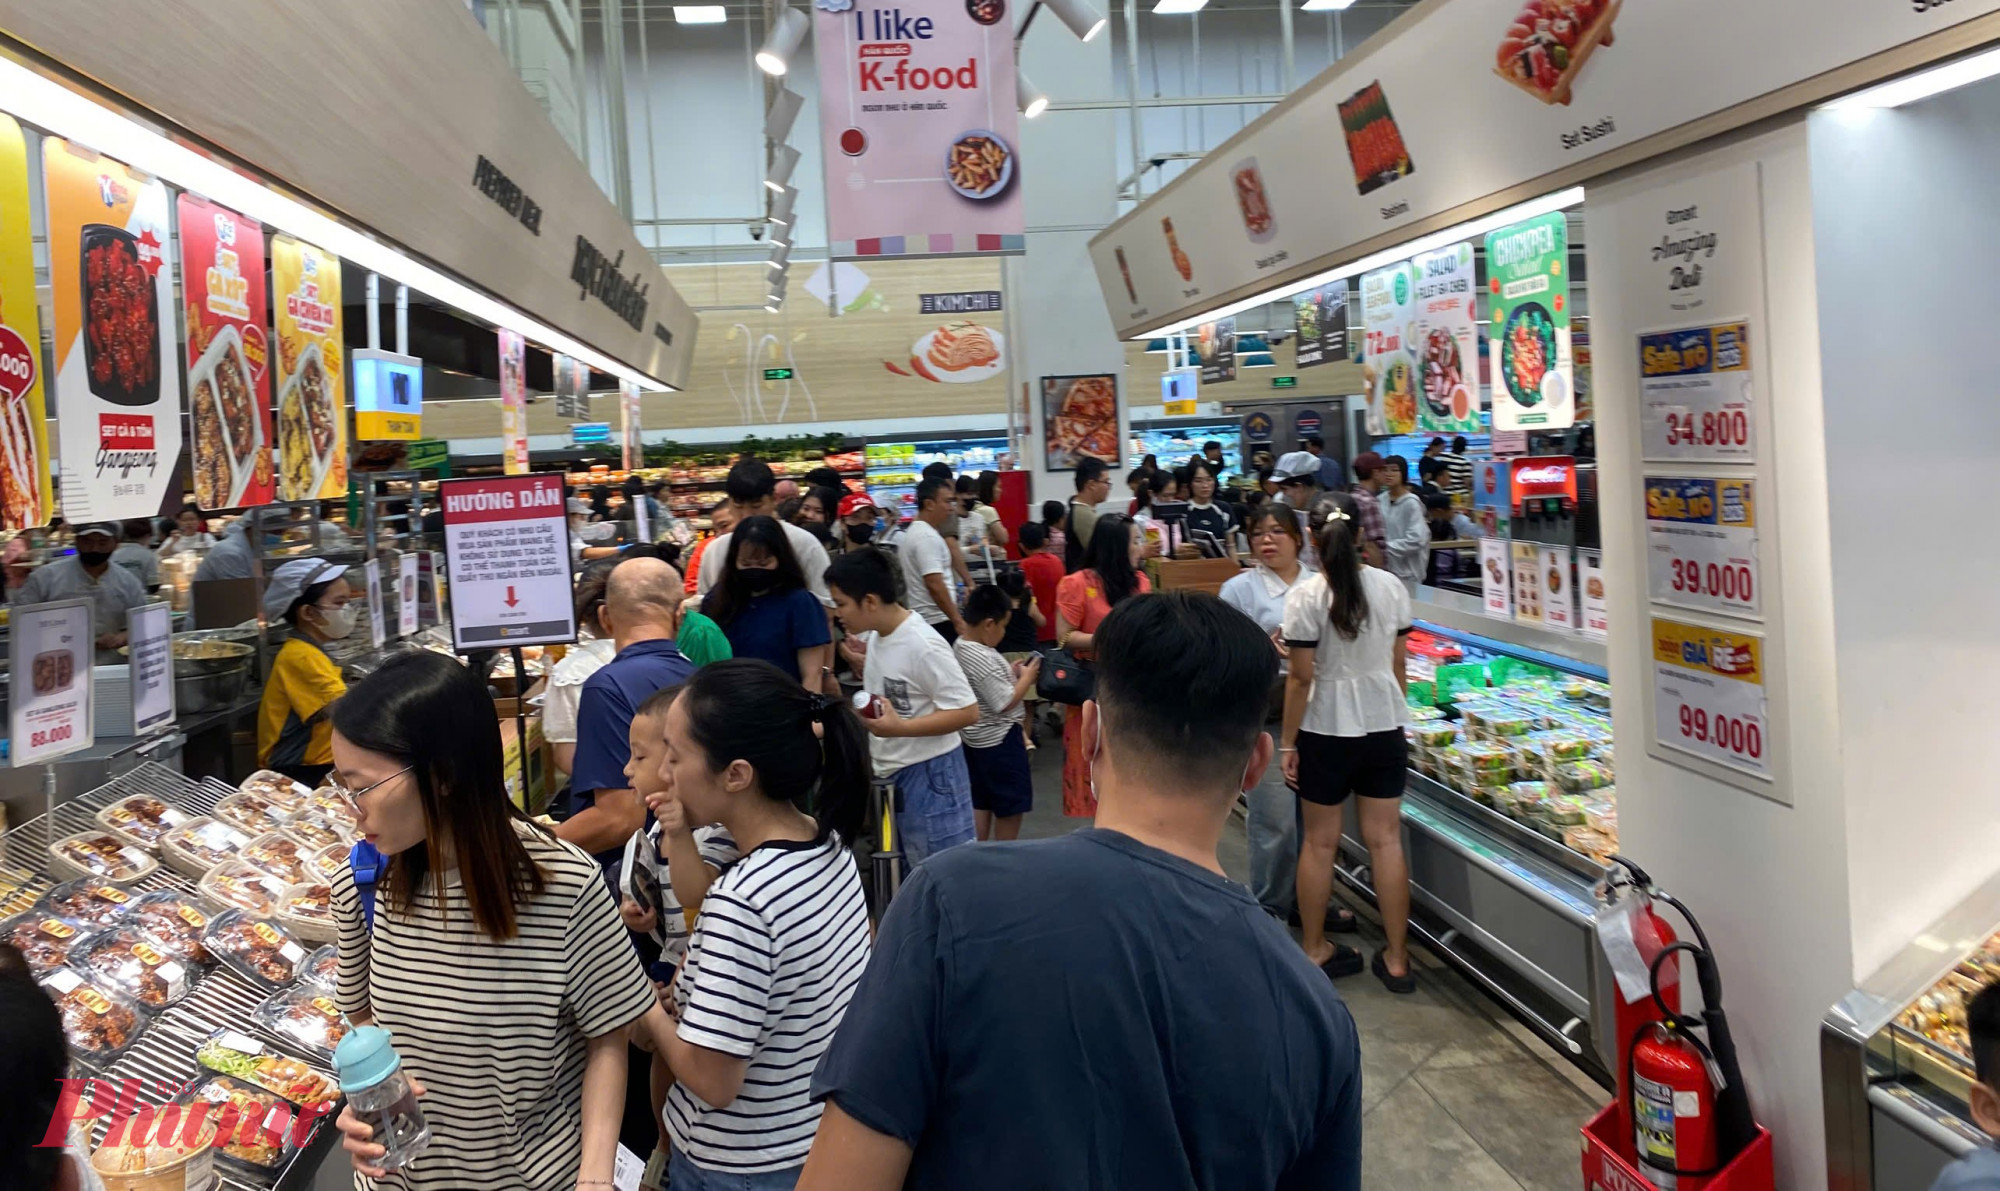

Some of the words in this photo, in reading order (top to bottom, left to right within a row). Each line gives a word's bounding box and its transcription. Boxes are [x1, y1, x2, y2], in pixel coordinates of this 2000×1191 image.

[856, 11, 864, 40] I
[875, 9, 934, 40] like
[859, 58, 978, 92] K-food
[1560, 130, 1582, 149] Set
[1581, 115, 1616, 142] Sushi
[1651, 231, 1718, 262] Amazing
[1427, 254, 1458, 277] SALAD
[1668, 264, 1703, 290] Deli
[934, 293, 990, 311] KIMCHI
[1665, 411, 1748, 446] 34.800
[446, 488, 515, 513] HƯỚNG
[520, 481, 561, 508] DẪN
[1671, 557, 1752, 603] 39.000
[1679, 703, 1762, 759] 99.000
